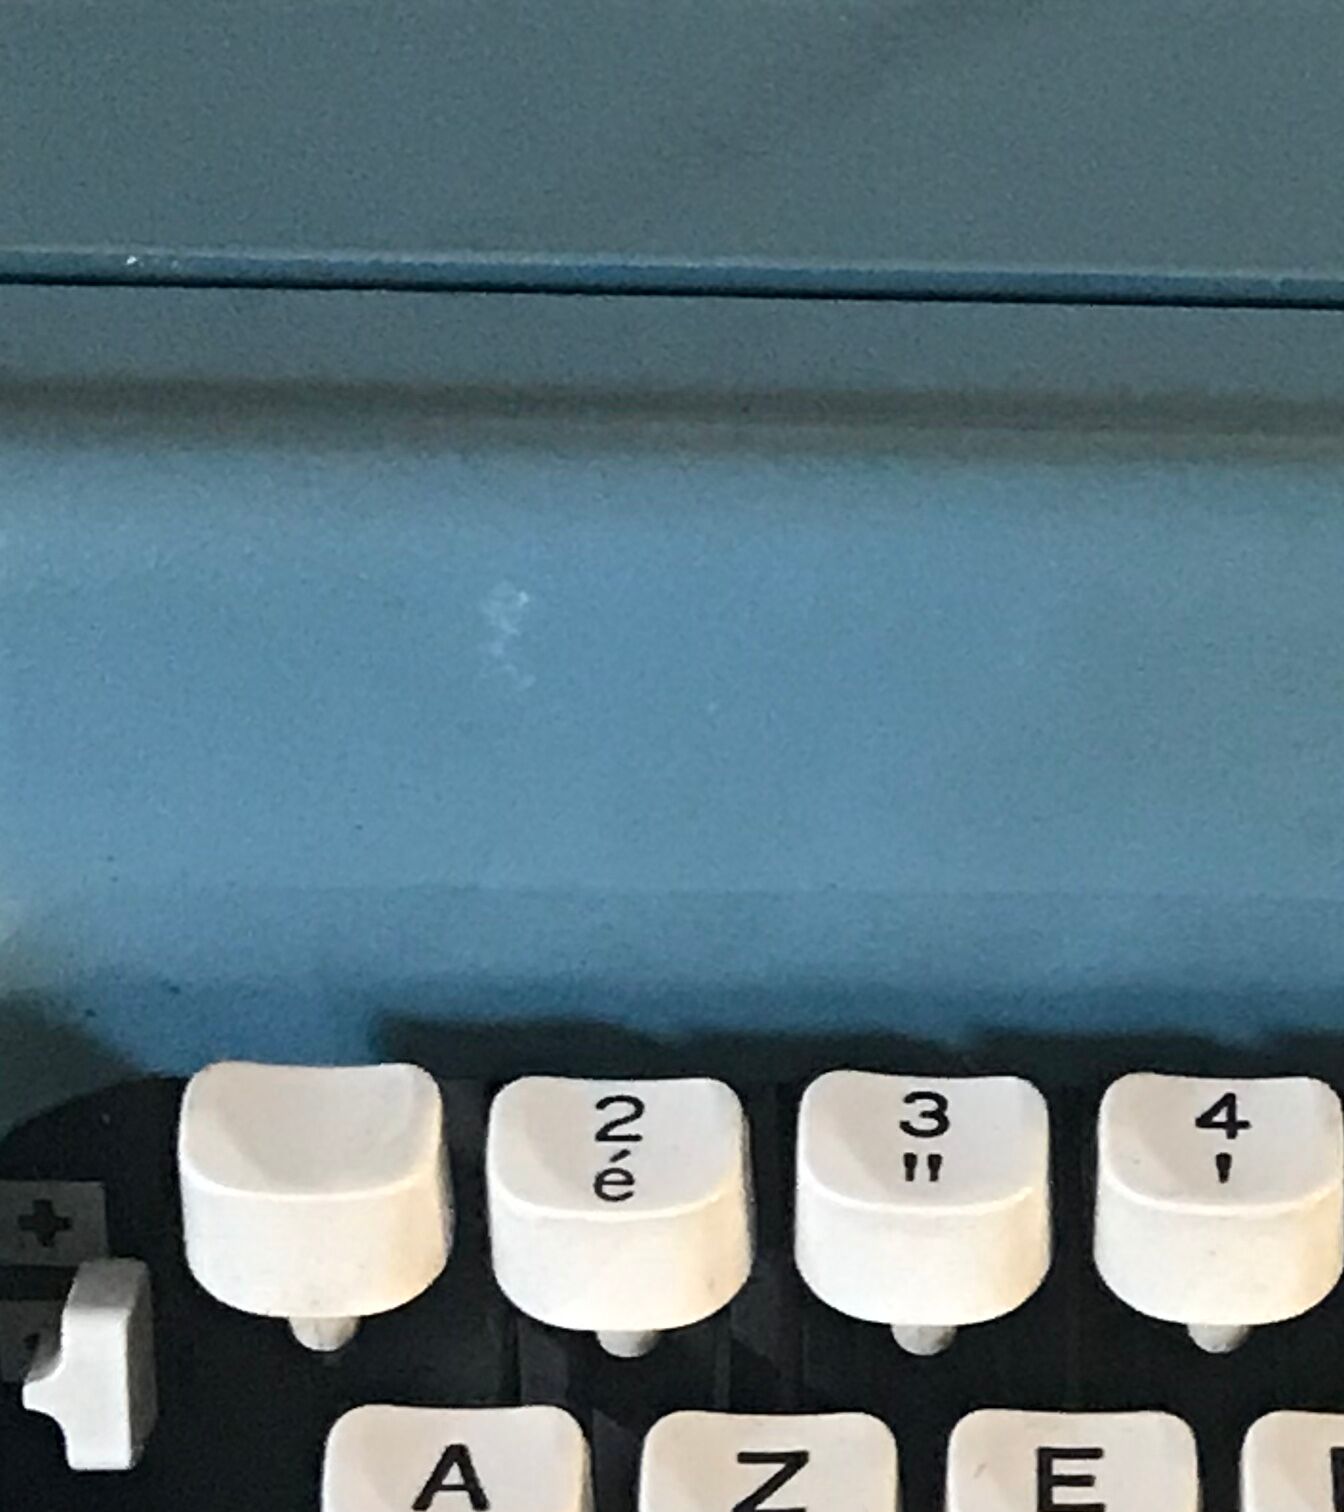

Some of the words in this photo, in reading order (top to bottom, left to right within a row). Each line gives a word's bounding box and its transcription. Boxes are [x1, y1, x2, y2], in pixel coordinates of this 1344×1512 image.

[593, 1093, 646, 1143] 2
[898, 1090, 951, 1140] 3
[1193, 1091, 1252, 1141] 4
[592, 1147, 636, 1197] é
[410, 1442, 491, 1512] A
